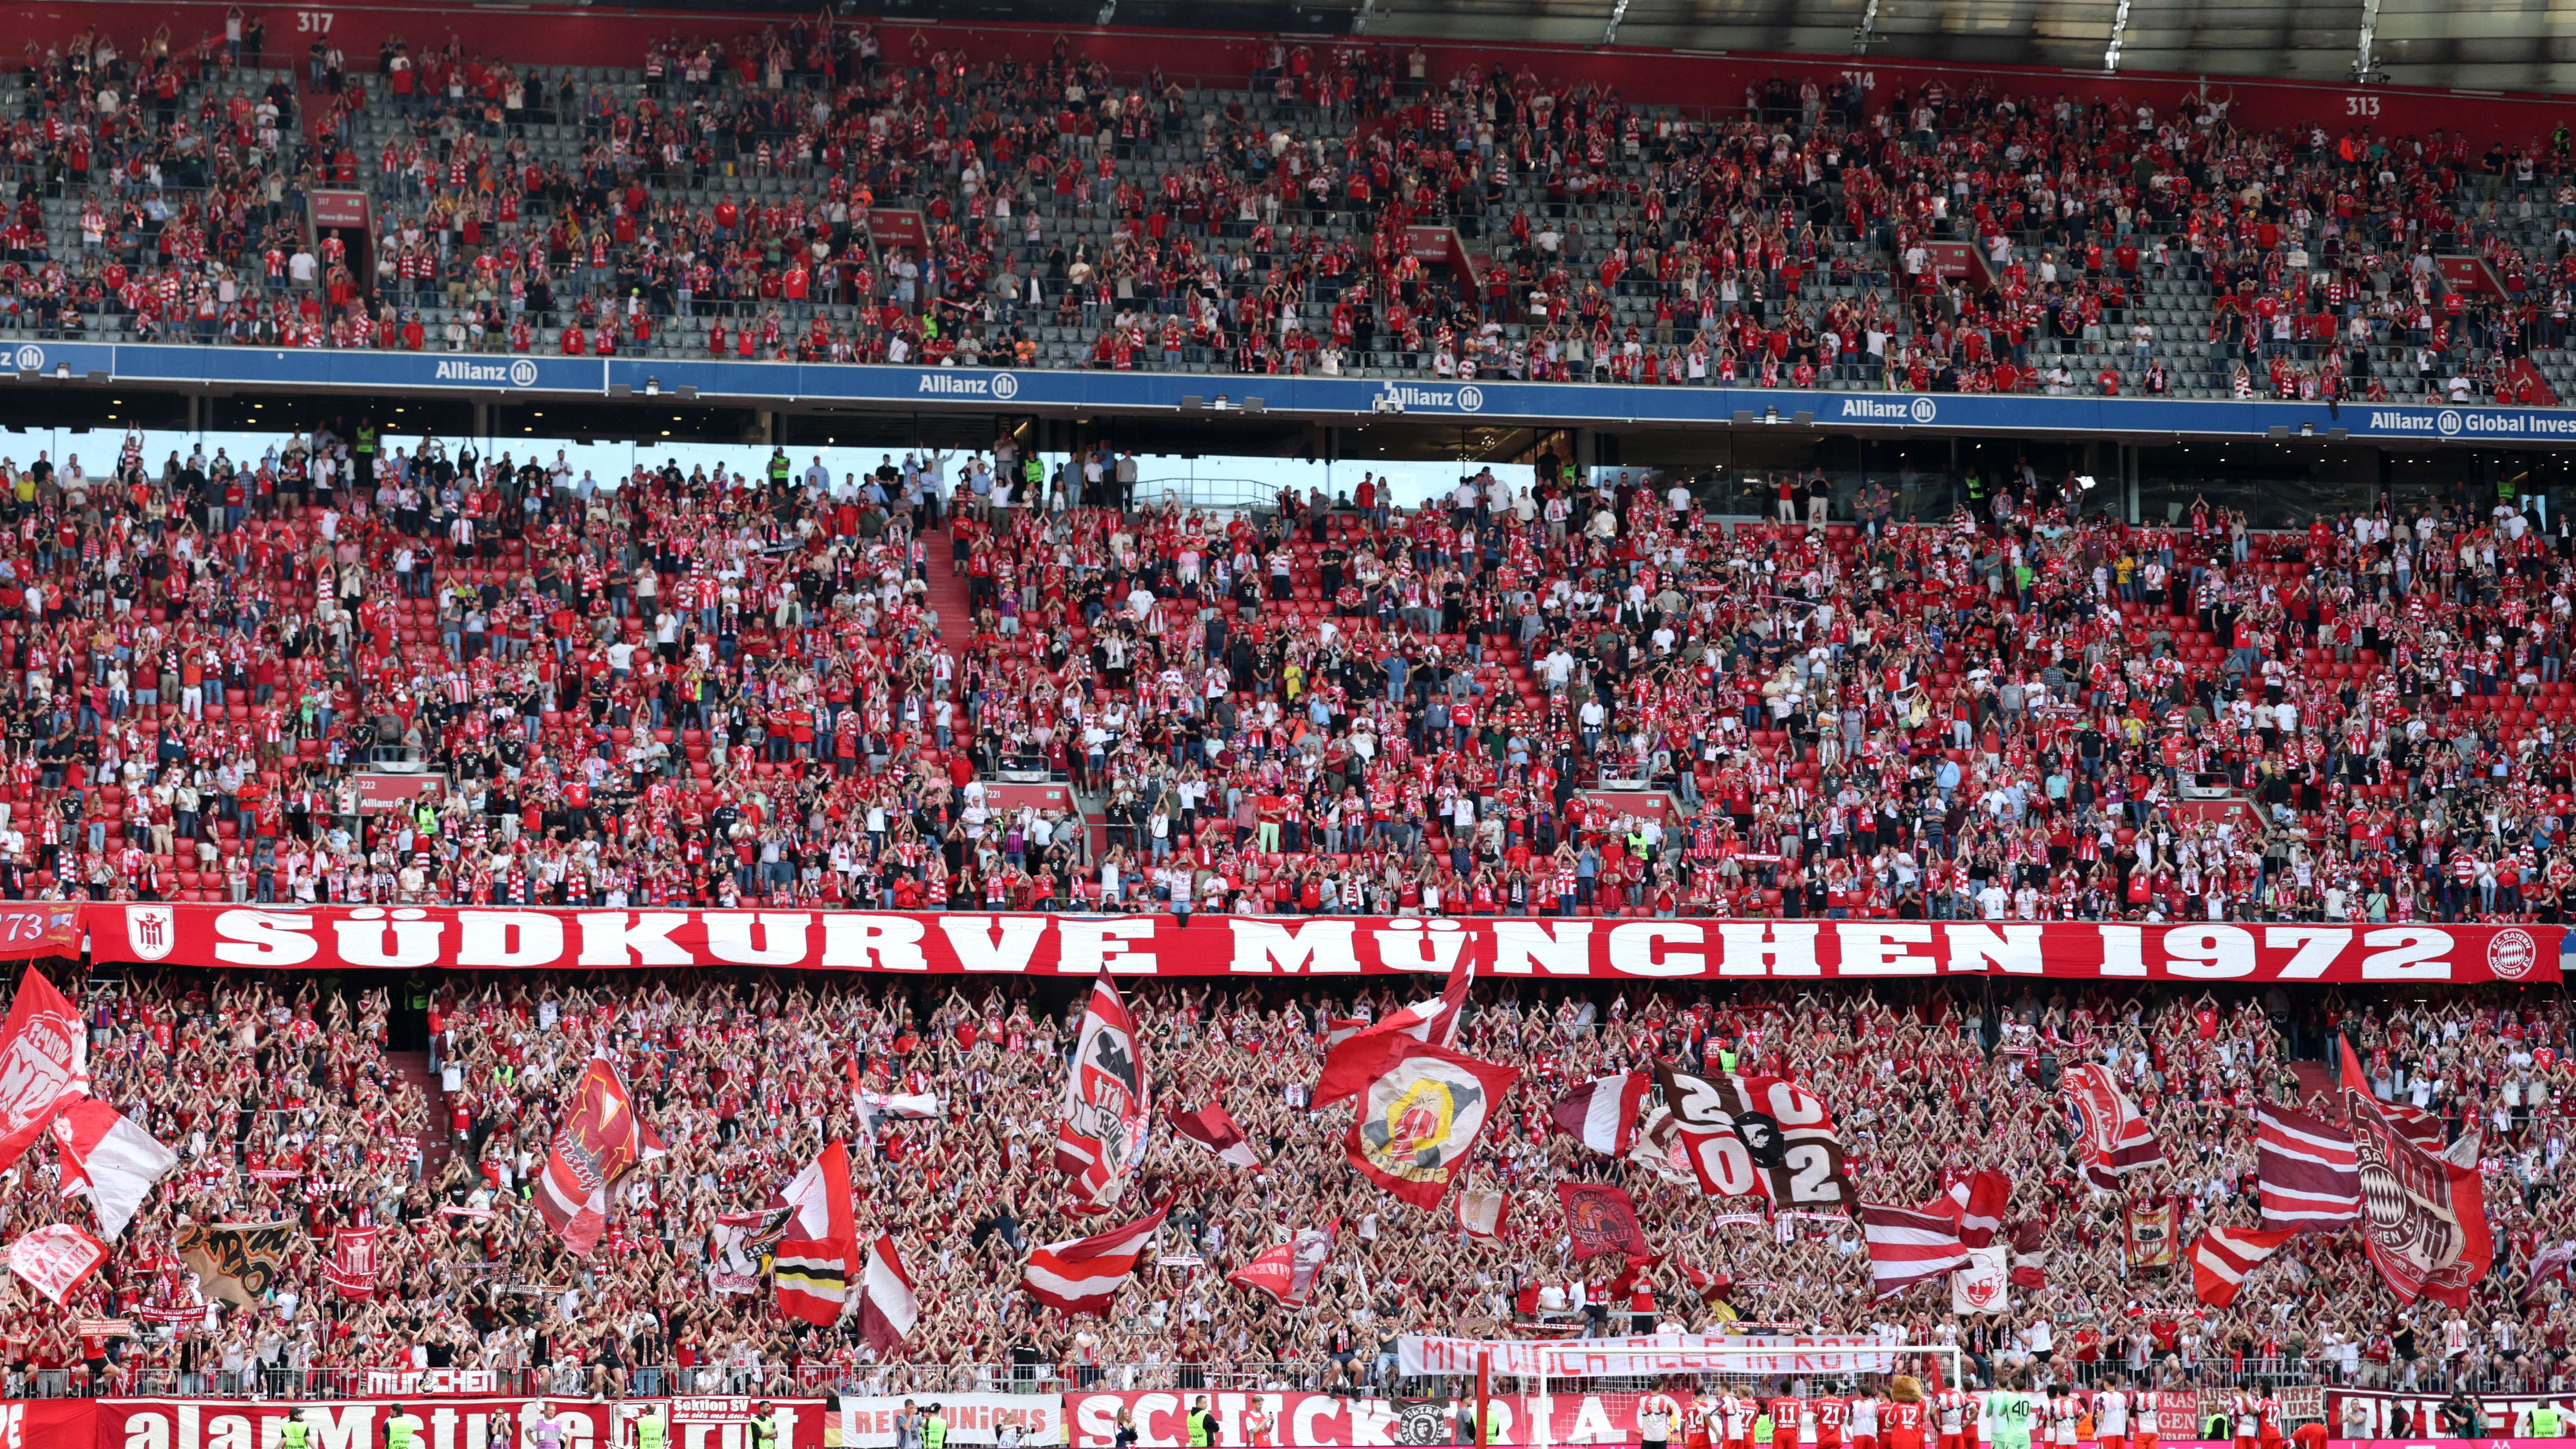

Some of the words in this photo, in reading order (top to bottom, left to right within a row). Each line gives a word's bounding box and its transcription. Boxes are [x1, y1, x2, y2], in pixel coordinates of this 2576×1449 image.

[297, 12, 334, 33] 317
[2346, 97, 2381, 115] 313
[318, 198, 330, 206] 317
[435, 361, 506, 380] Allianz
[919, 375, 987, 394] Allianz
[1388, 387, 1454, 406] Allianz
[1842, 399, 1907, 417] Allianz
[2370, 412, 2433, 430] Allianz
[2466, 414, 2525, 431] Global
[361, 781, 376, 790] 222
[987, 790, 1000, 798] 221
[361, 798, 394, 808] Allianz
[214, 907, 1159, 975] SÜDKURVE
[1230, 915, 2046, 977] MÜNCHEN
[2099, 923, 2455, 979] 1972
[2503, 932, 2531, 949] BAYERN
[2132, 1213, 2166, 1224] ULTRA
[1514, 1322, 1567, 1330] DURCHBOXEN
[1423, 1340, 1608, 1376] MITTWOCH
[1745, 1339, 1777, 1371] IN
[674, 1399, 728, 1411] Sektion
[730, 1399, 749, 1412] SV
[1778, 1405, 1796, 1423] 11
[2012, 1400, 2030, 1417] 40
[2266, 1404, 2280, 1423] 17
[2288, 1402, 2321, 1416] UNS
[1688, 1409, 1705, 1428] 14
[1823, 1406, 1839, 1424] 21
[1901, 1408, 1917, 1425] 12
